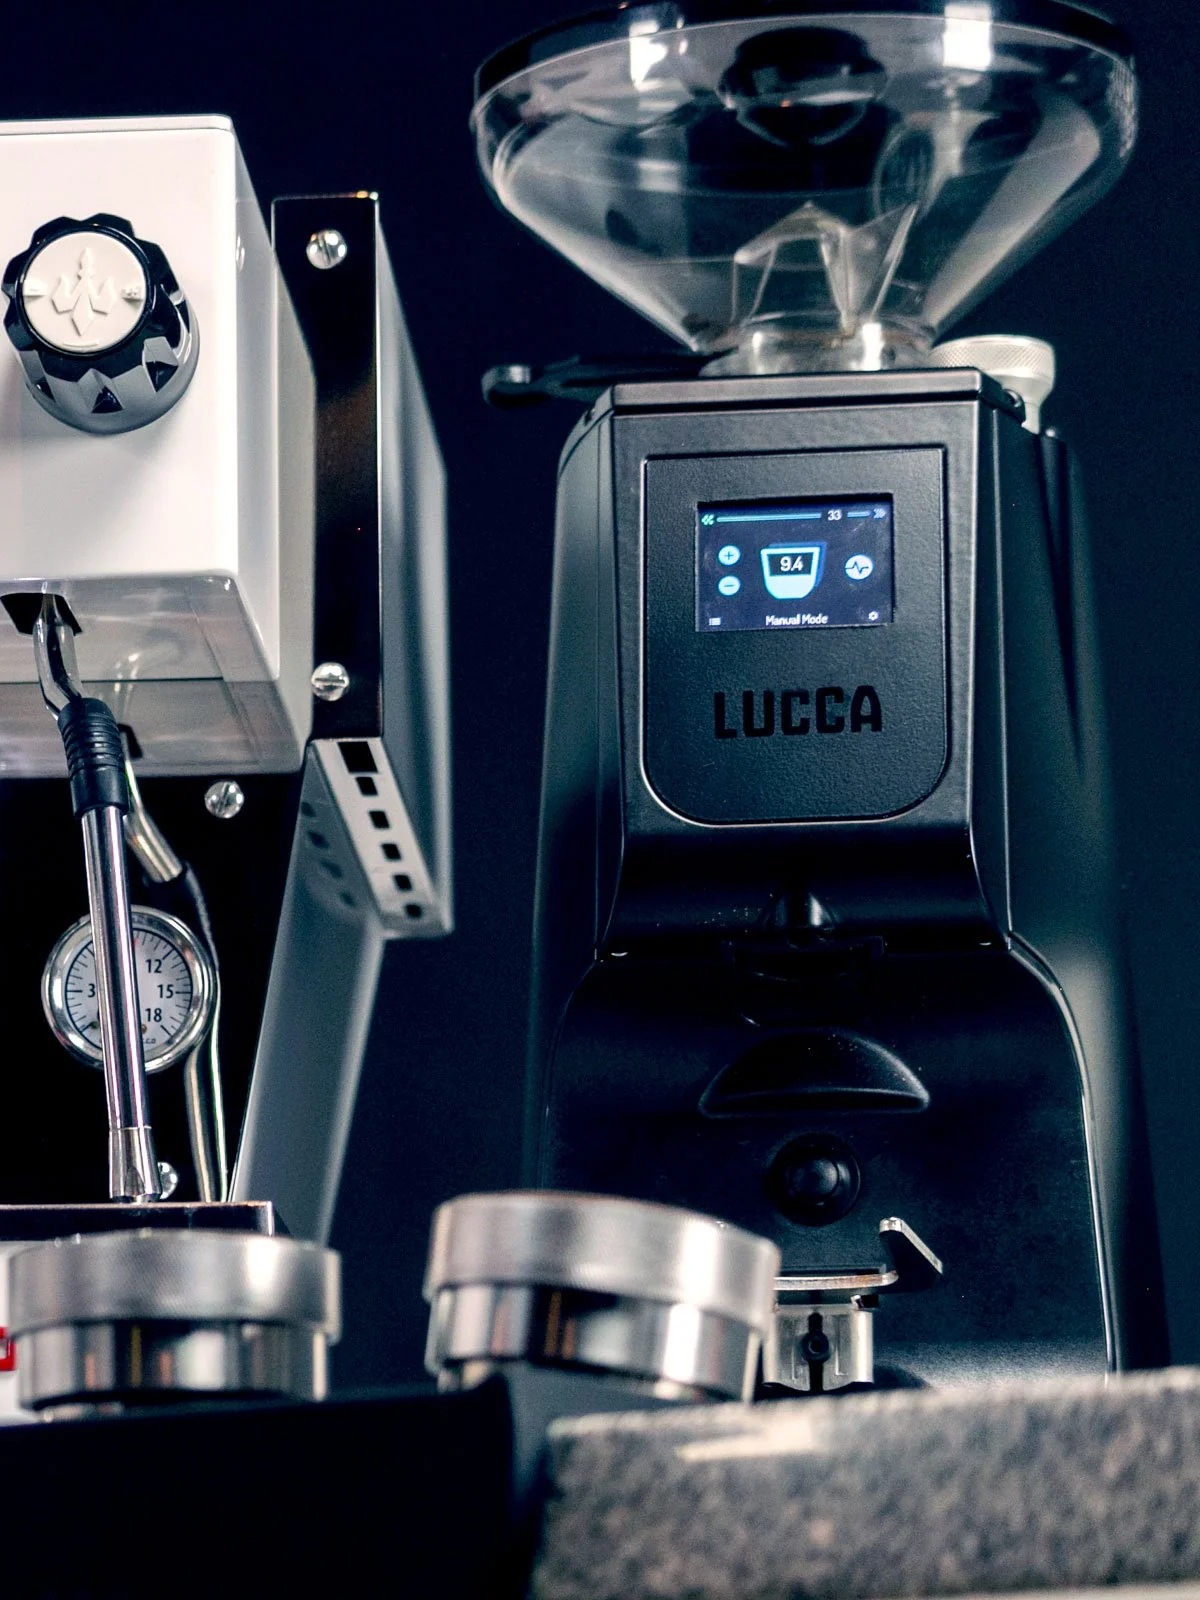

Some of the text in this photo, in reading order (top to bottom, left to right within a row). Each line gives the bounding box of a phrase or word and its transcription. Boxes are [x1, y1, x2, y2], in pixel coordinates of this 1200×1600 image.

[827, 509, 842, 521] 33
[780, 556, 804, 572] 9.4
[765, 613, 829, 626] Manual Mode
[714, 685, 883, 739] LUCCA
[145, 958, 162, 973] 12
[87, 983, 96, 998] 3
[158, 984, 174, 999] 15
[145, 1007, 162, 1022] 18
